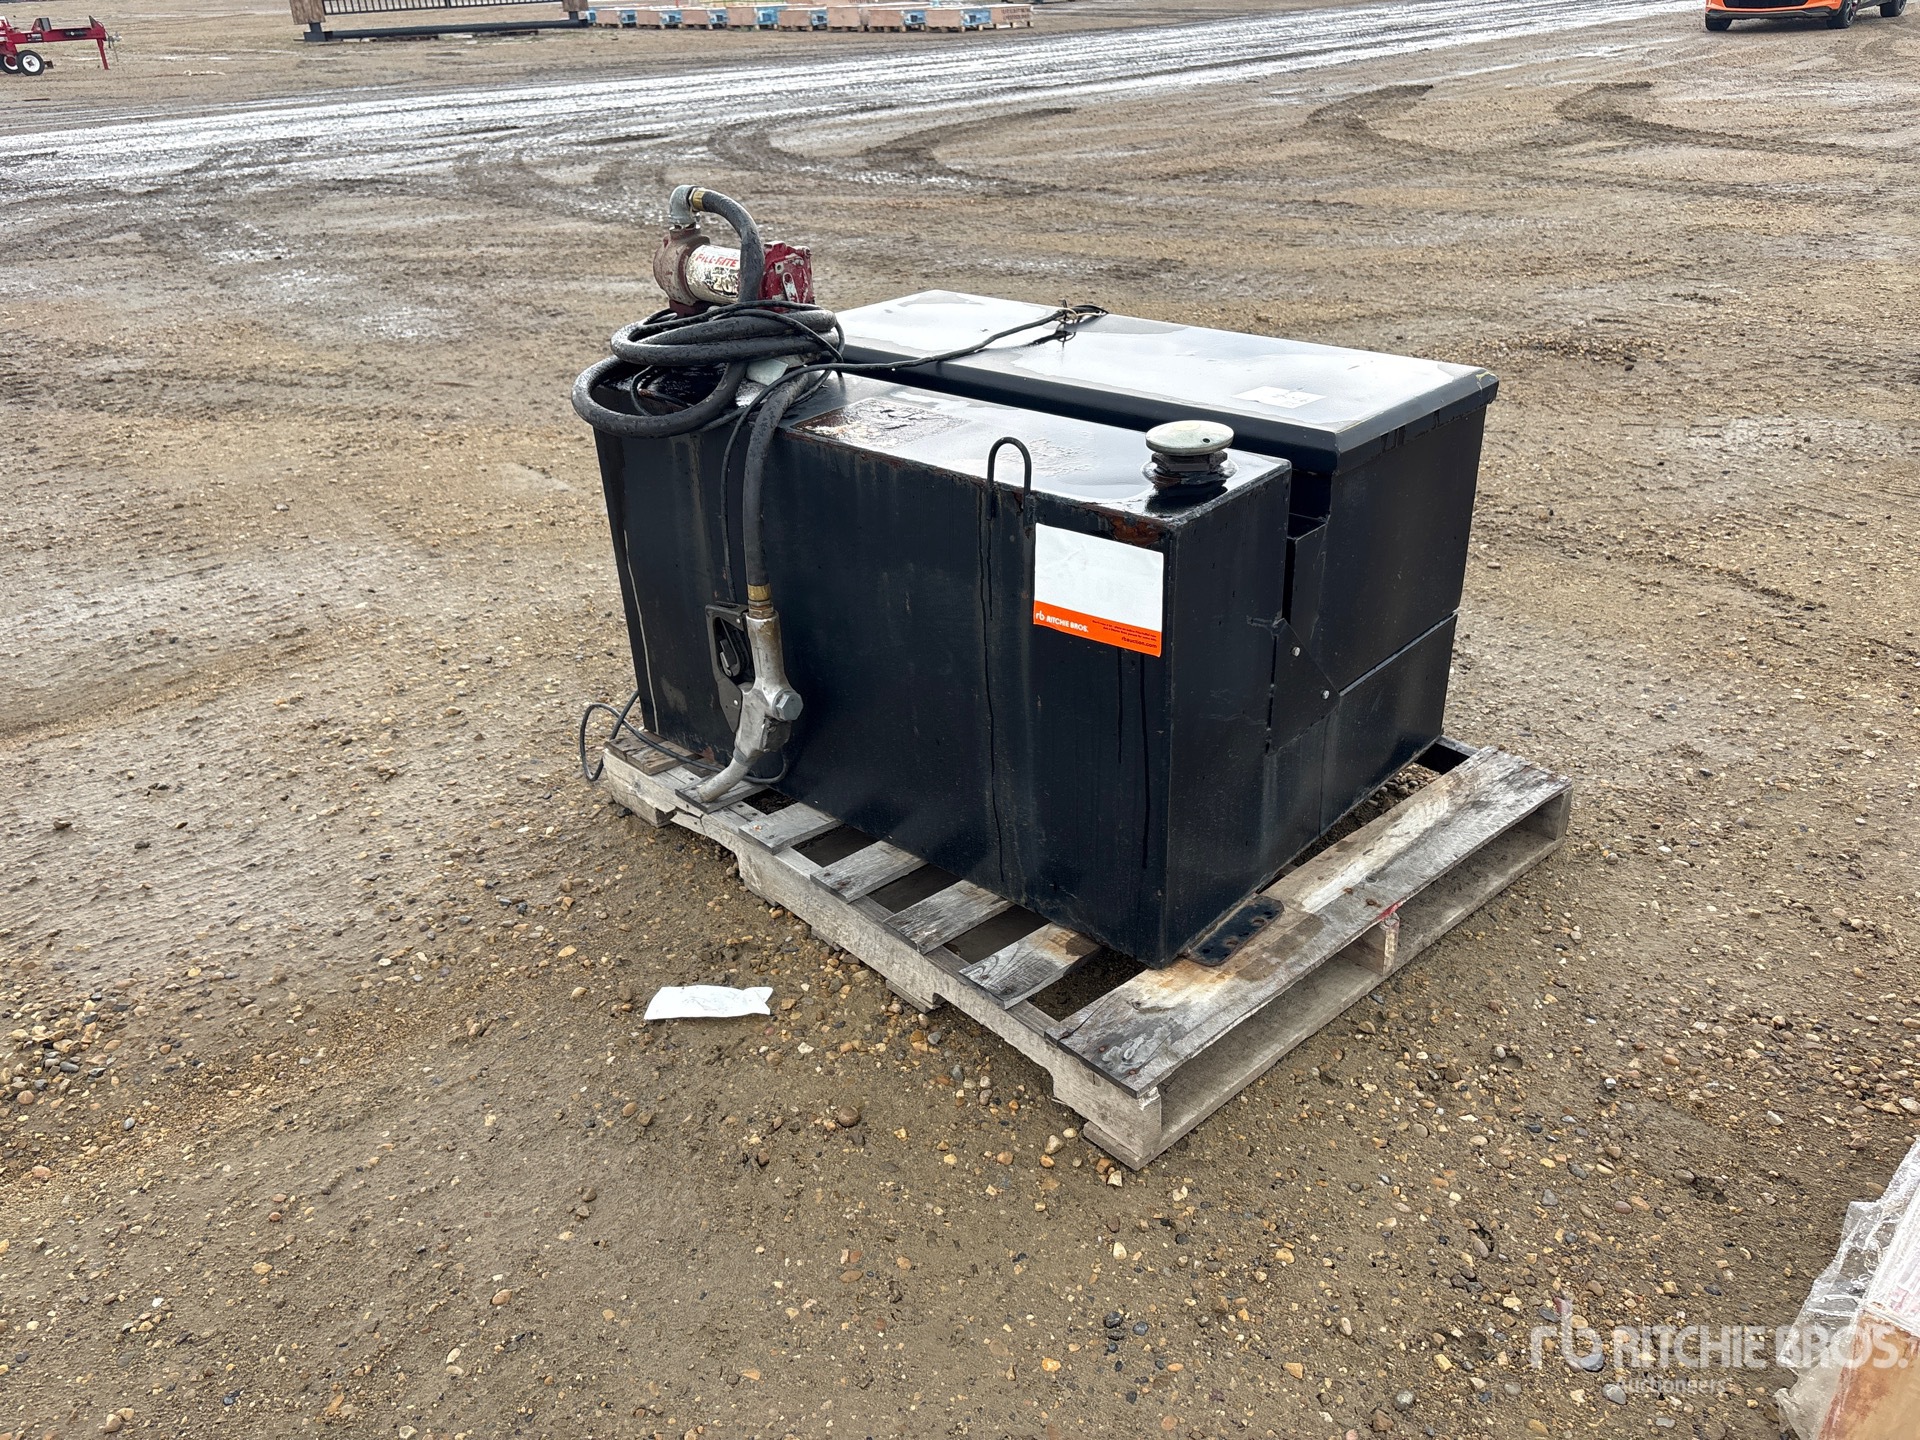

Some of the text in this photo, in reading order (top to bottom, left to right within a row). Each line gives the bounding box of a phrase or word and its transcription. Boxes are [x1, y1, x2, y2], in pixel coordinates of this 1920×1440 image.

[695, 253, 739, 267] FILL-RITE
[1036, 610, 1045, 620] rb
[1046, 615, 1069, 626] RITCHIE
[1070, 621, 1089, 633] BROS.
